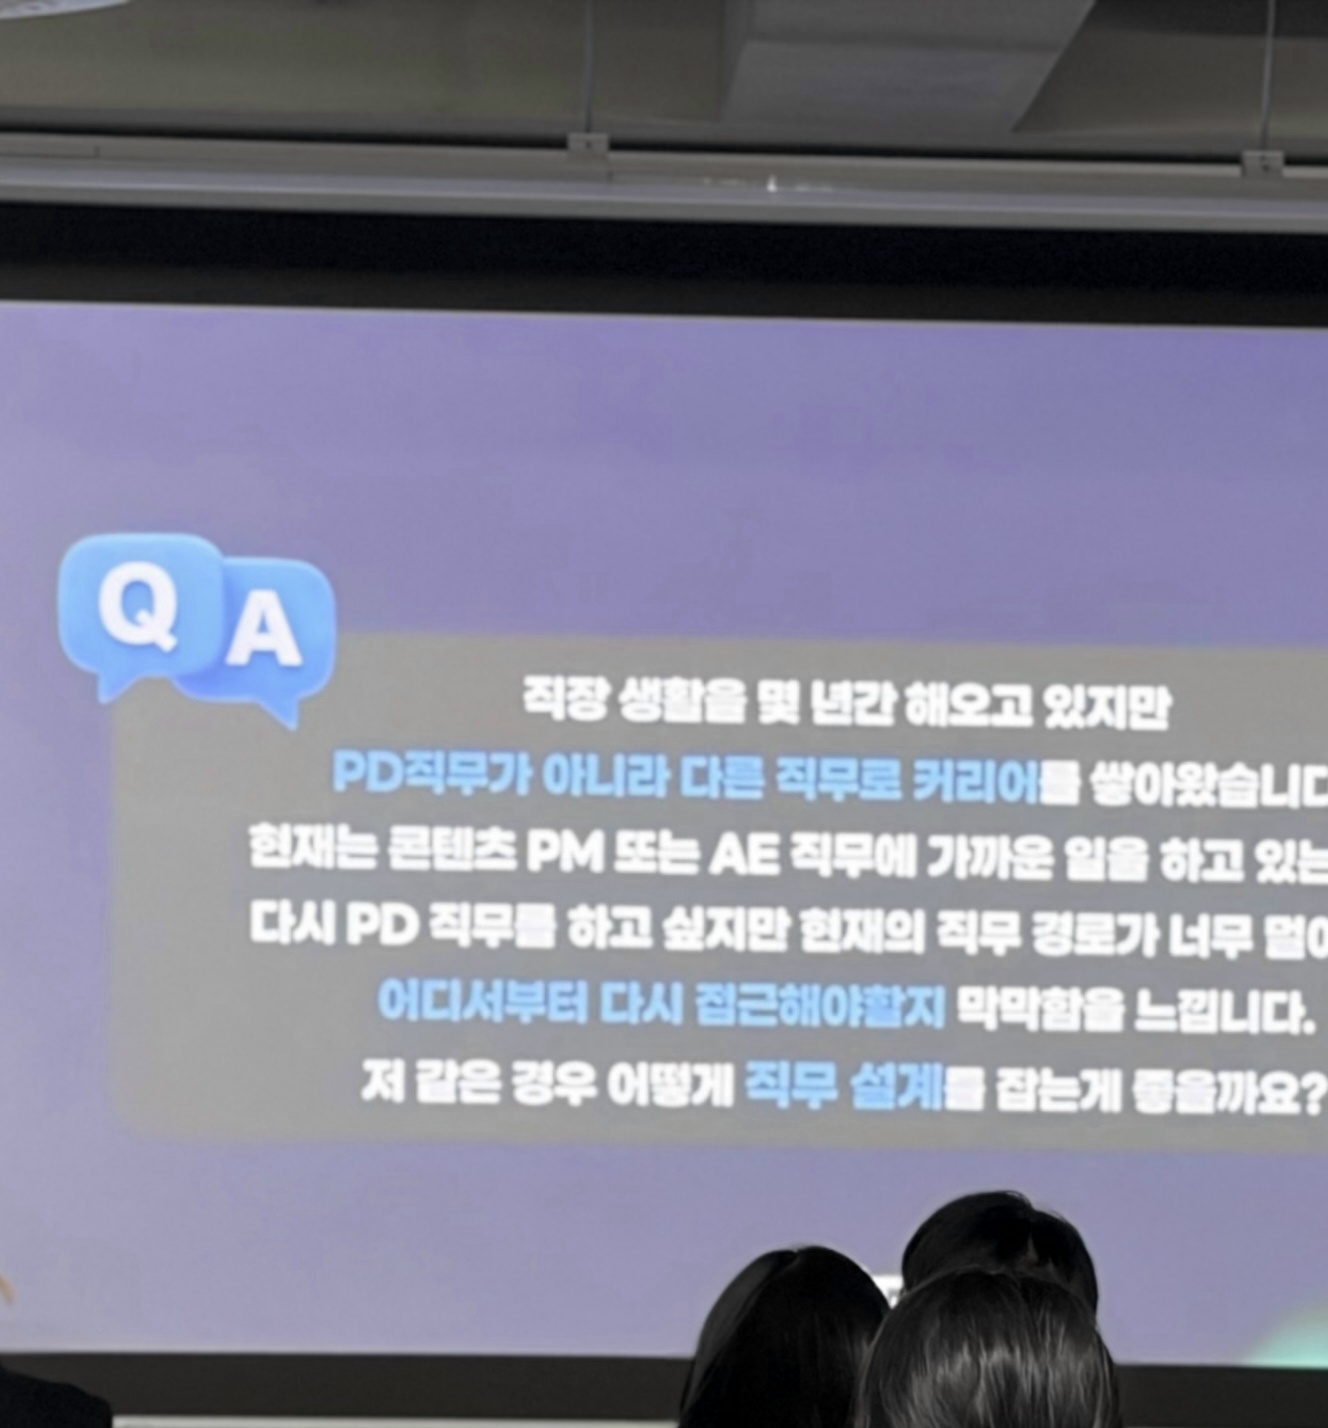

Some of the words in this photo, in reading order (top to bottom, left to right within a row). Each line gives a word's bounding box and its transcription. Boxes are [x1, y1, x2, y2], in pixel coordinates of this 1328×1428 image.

[98, 560, 178, 653] Q
[224, 588, 304, 667] A
[523, 674, 613, 723] 직장
[618, 675, 749, 725] 생활을
[757, 677, 801, 725] 몇
[810, 678, 899, 728] 년간
[903, 680, 1035, 728] 해오고
[1042, 682, 1174, 731] 있지만
[333, 748, 535, 797] PD직무가
[542, 750, 672, 799] 아니라
[679, 753, 767, 801] 다른
[775, 754, 903, 802] 직무로
[913, 757, 1083, 806] 커리어를
[248, 820, 380, 870] 현재는
[387, 823, 518, 872] 콘텐츠
[526, 827, 606, 874] PM
[613, 828, 702, 876] 또는
[708, 830, 782, 876] AE
[790, 830, 918, 879] 직무에
[927, 832, 1056, 881] 가까운
[1063, 834, 1150, 882] 일을
[1159, 836, 1246, 883] 하고
[250, 898, 337, 945] 다시
[346, 900, 421, 946] PD
[428, 900, 558, 949] 직무를
[566, 902, 654, 950] 하고
[661, 903, 793, 954] 싶지만
[798, 905, 927, 955] 현재의
[936, 908, 1023, 956] 직무
[1032, 909, 1162, 958] 경로가
[1168, 911, 1255, 961] 너무
[377, 976, 589, 1024] 어디서부터
[600, 979, 684, 1026] 다시
[695, 980, 947, 1029] 접근해야할지
[957, 984, 1127, 1033] 막막함을
[1134, 986, 1317, 1036] 느낍니다.
[361, 1056, 406, 1103] 저
[415, 1057, 503, 1105] 같은
[511, 1059, 599, 1106] 경우
[607, 1060, 735, 1108] 어떻게
[744, 1059, 839, 1110] 직무
[850, 1060, 987, 1112] 설계를
[995, 1066, 1124, 1114] 잡는게
